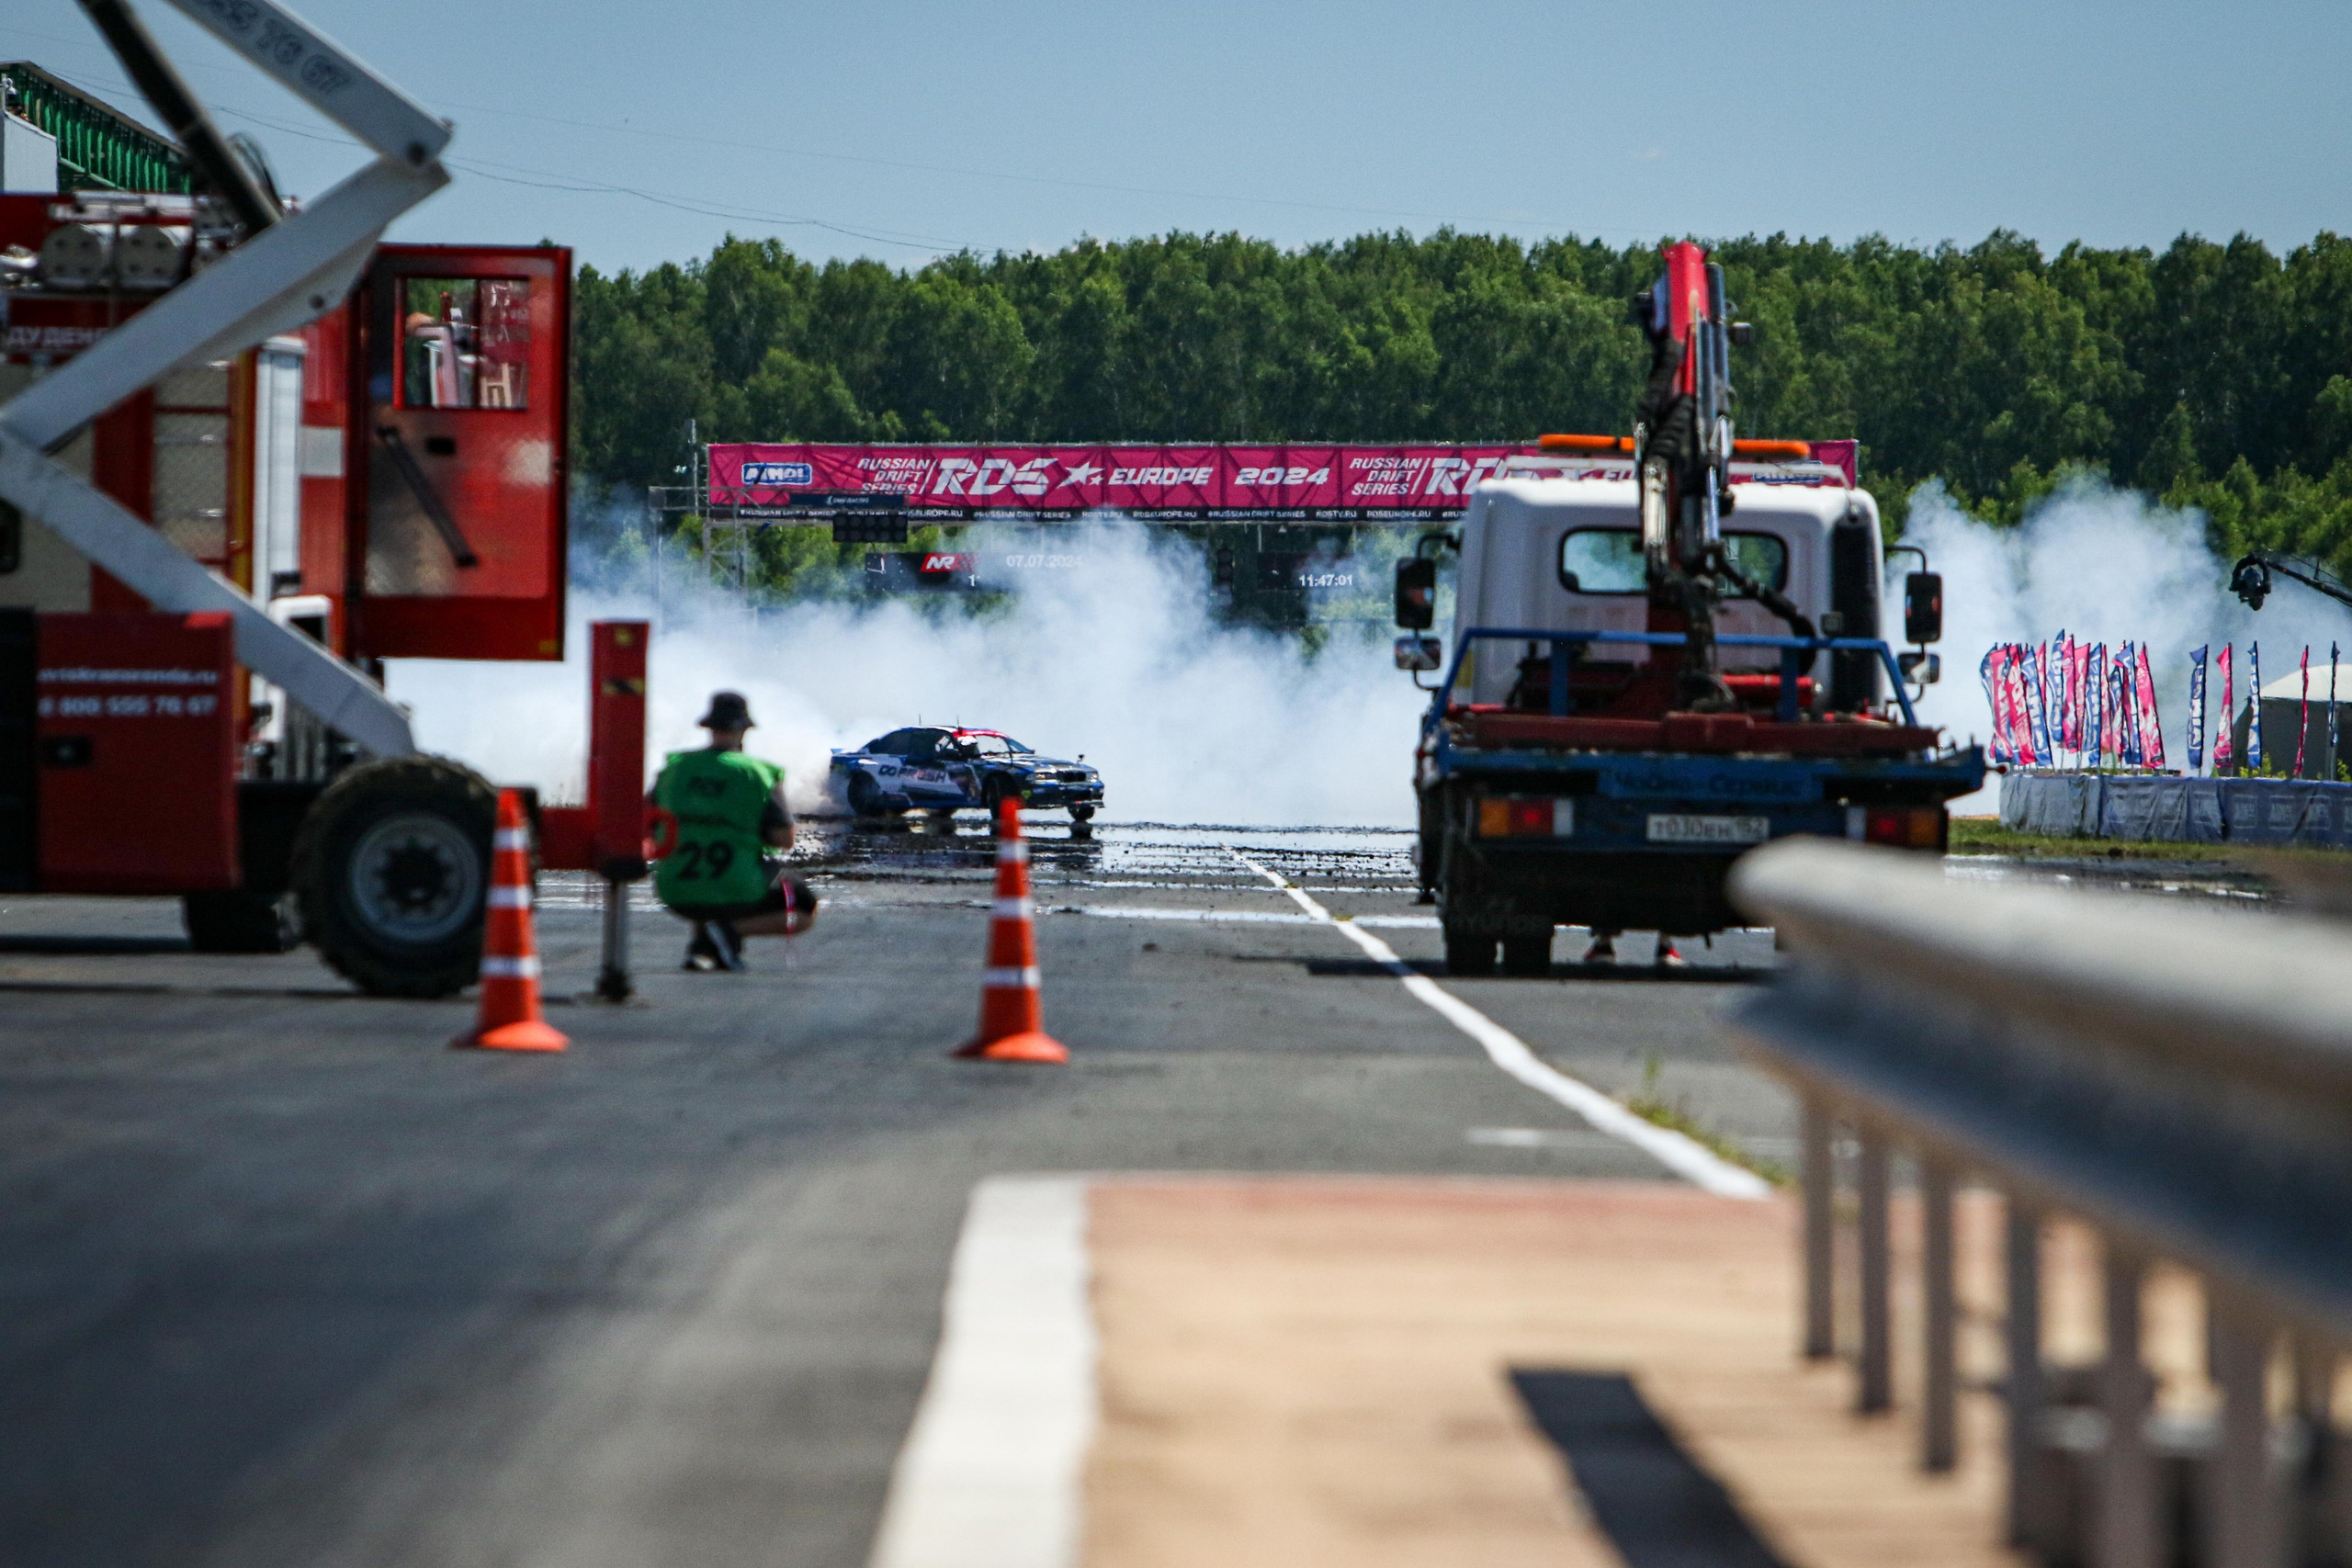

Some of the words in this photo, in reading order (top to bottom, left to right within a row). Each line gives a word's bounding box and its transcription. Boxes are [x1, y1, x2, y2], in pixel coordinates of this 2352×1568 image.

[857, 457, 930, 470] RUSSIAN
[1349, 457, 1422, 469] RUSSIAN
[873, 470, 923, 482] DRIFT
[932, 457, 1057, 495] RDS
[1107, 467, 1213, 485] EUROPE
[1235, 467, 1330, 485] 2024
[1366, 469, 1416, 481] DRIFT
[862, 482, 918, 495] SERIES
[1351, 482, 1409, 495] SERIES
[1006, 554, 1082, 568] 07.07.2024
[1298, 574, 1353, 587] 11:47:01
[677, 840, 734, 879] 29
